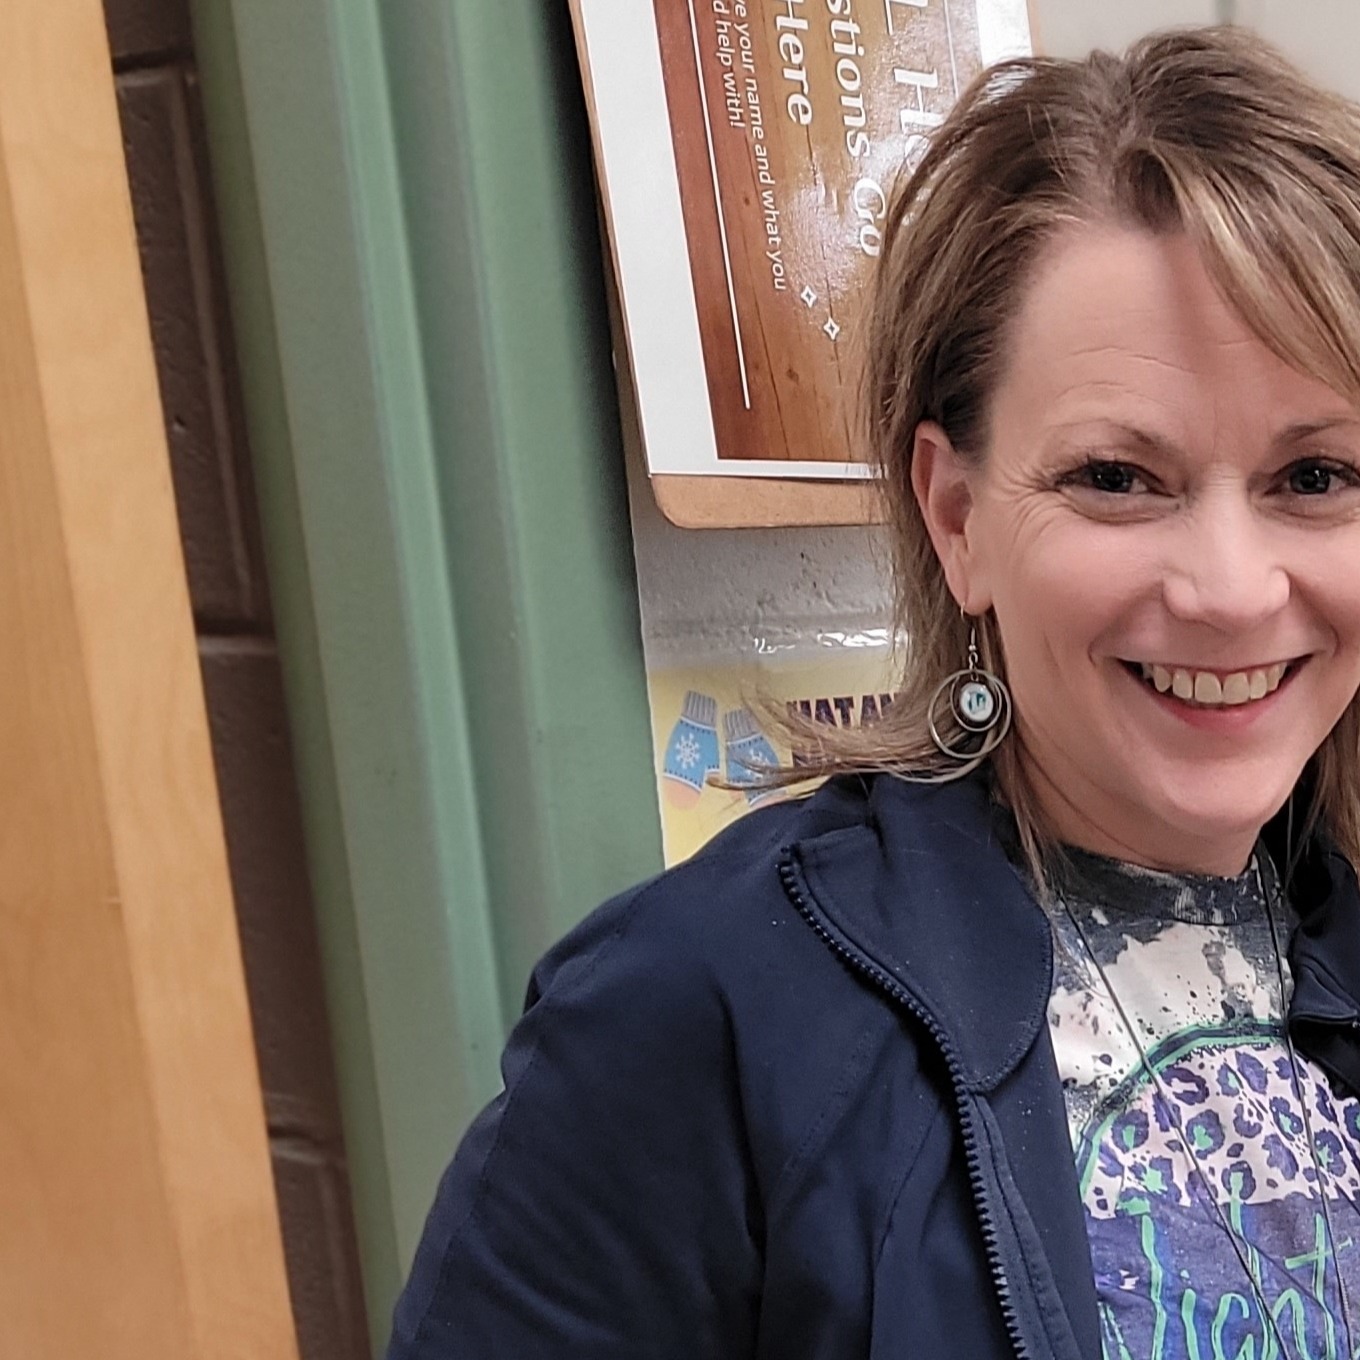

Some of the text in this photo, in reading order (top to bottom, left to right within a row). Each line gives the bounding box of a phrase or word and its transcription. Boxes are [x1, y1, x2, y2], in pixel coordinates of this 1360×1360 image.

[715, 19, 735, 67] help
[733, 22, 755, 74] your
[775, 0, 814, 126] Here
[723, 71, 745, 129] with!
[745, 77, 765, 140] name
[754, 142, 776, 185] and
[761, 188, 783, 246] what
[854, 177, 886, 258] Go
[767, 250, 787, 291] you
